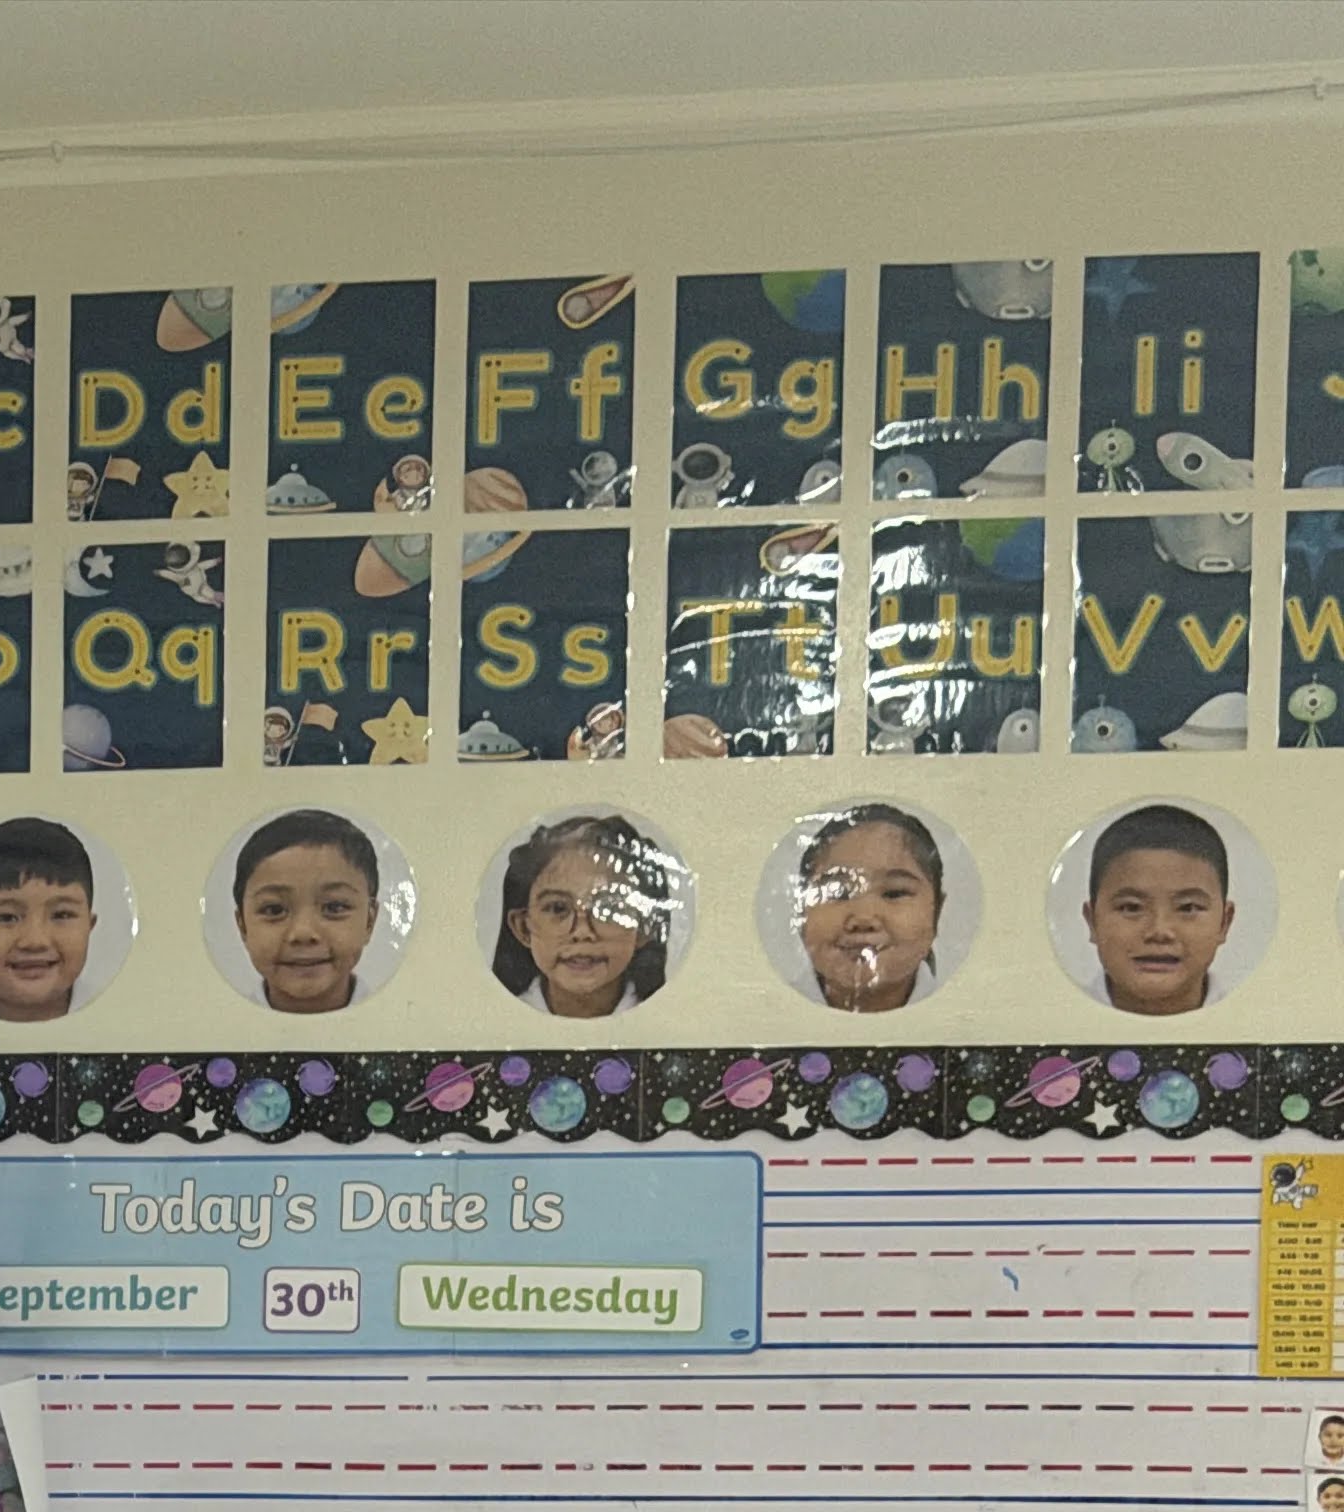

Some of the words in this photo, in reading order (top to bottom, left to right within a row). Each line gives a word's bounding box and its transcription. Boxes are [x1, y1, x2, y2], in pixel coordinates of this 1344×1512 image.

[78, 363, 221, 447] Dd
[278, 357, 425, 440] Ee
[477, 344, 621, 445] Ff
[684, 339, 837, 439] Gg
[884, 337, 1040, 422] Hh
[74, 610, 214, 705] Qq
[280, 610, 414, 692] Rr
[477, 606, 609, 687] Ss
[880, 593, 1035, 678] Uu
[1083, 594, 1247, 673] Vv
[90, 1176, 317, 1249] Today's
[340, 1182, 489, 1233] Date
[511, 1176, 564, 1233] is
[270, 1278, 355, 1318] 30th
[422, 1276, 679, 1324] Wednesday
